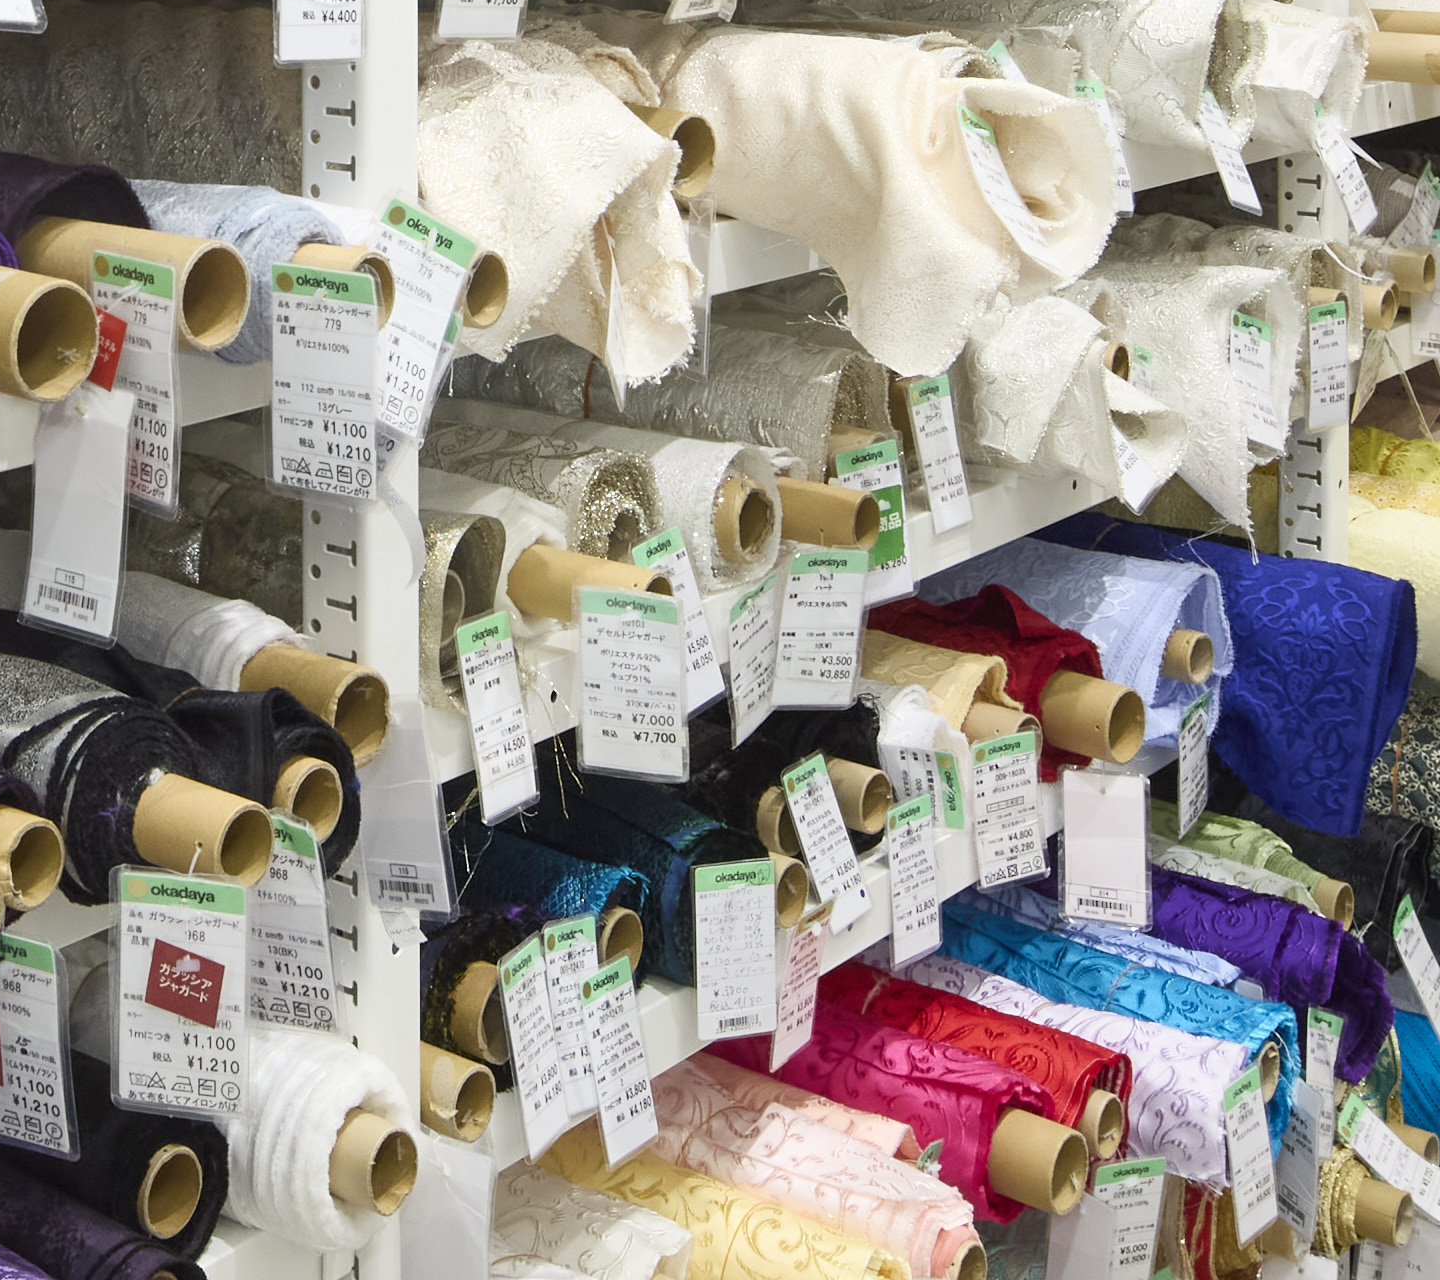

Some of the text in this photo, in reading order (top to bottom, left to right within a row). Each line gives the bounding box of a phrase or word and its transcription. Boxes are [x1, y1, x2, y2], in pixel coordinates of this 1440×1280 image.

[322, 10, 357, 23] ¥4,400
[294, 270, 349, 294] okadaya
[323, 317, 342, 331] 779
[322, 420, 368, 440] ¥1,100
[327, 441, 372, 462] ¥1,210
[821, 654, 854, 668] ¥3,500
[820, 668, 850, 681] ¥3,850
[631, 712, 675, 728] ¥7,000
[632, 730, 677, 746] ¥7,700
[268, 866, 289, 882] 968
[149, 883, 216, 904] okadaya
[275, 963, 324, 981] ¥1,100
[280, 981, 330, 1000] ¥1,210
[182, 1032, 236, 1053] ¥1,100
[187, 1054, 241, 1075] ¥1,210
